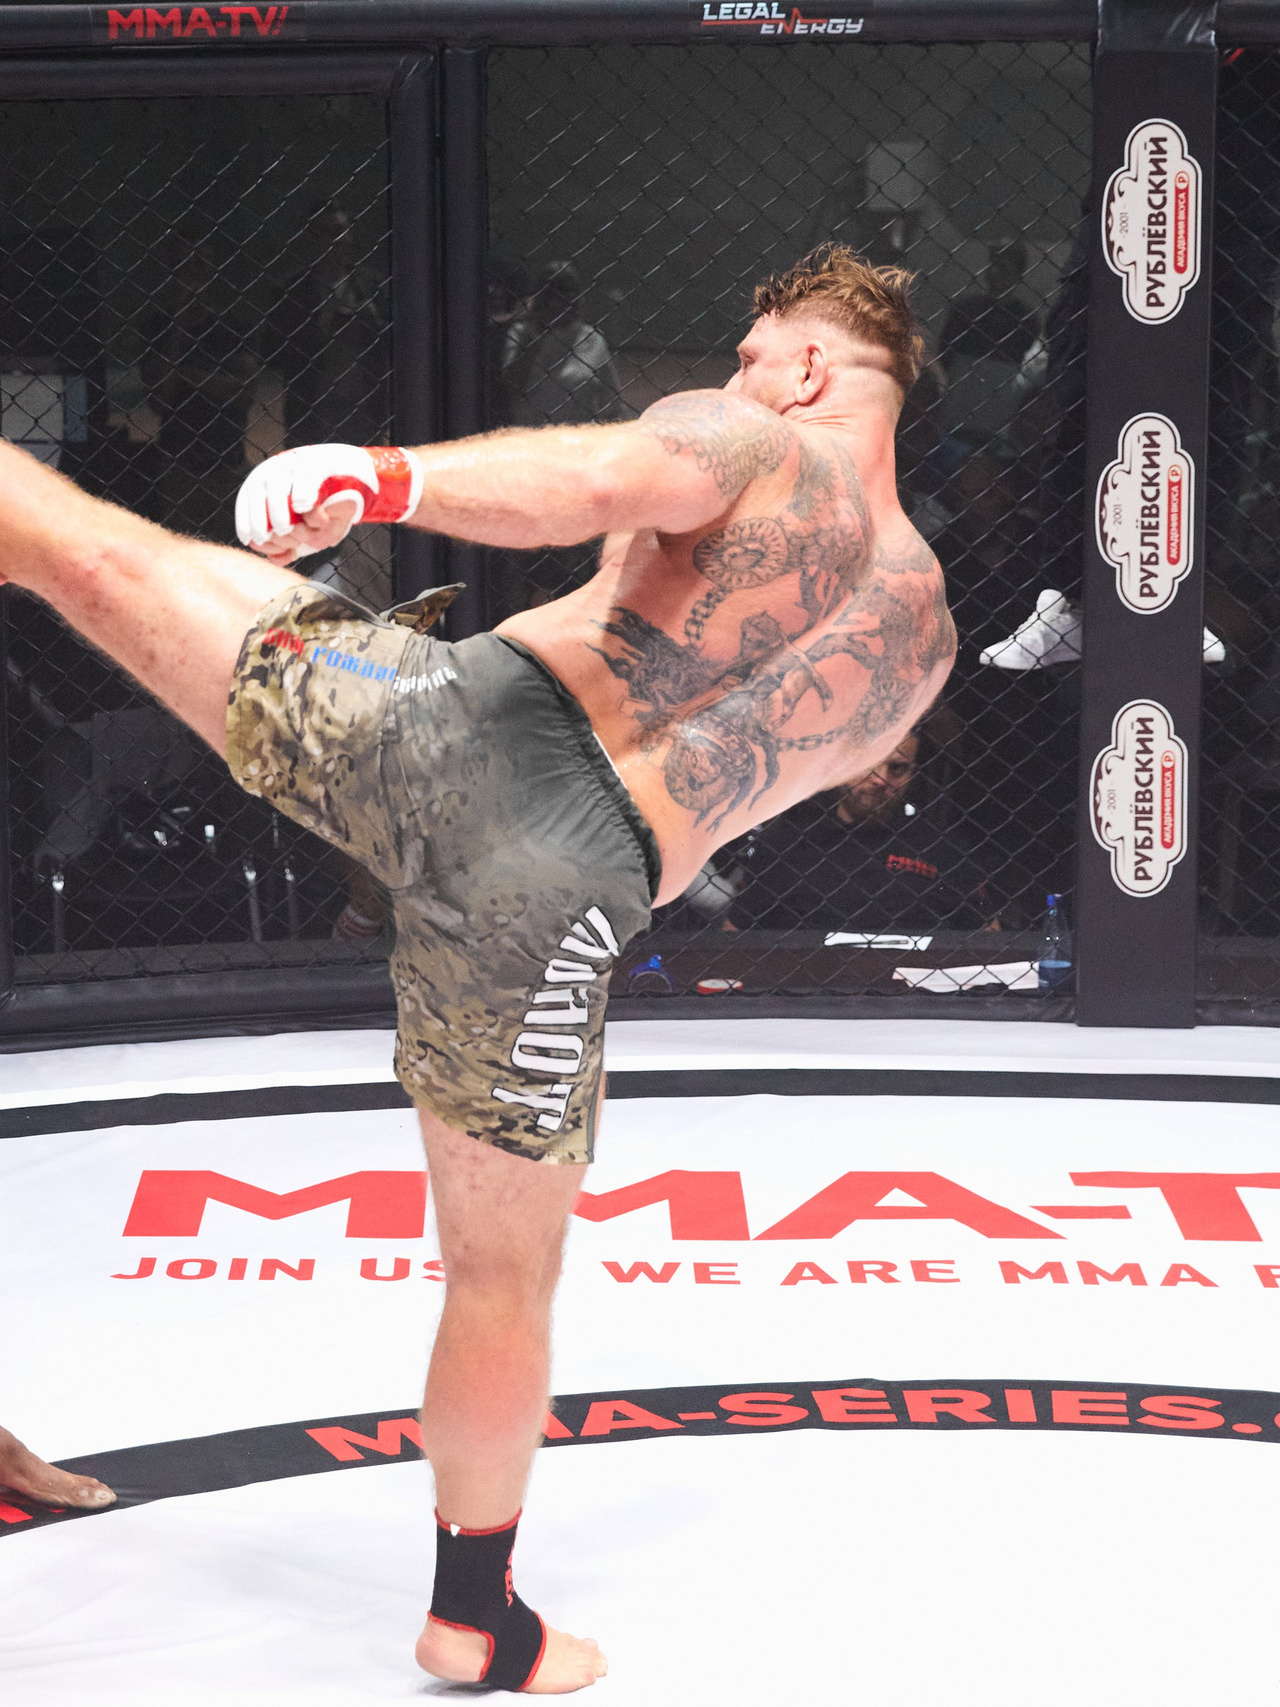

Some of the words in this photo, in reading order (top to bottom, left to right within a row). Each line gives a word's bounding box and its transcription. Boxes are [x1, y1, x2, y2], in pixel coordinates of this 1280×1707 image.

[703, 2, 786, 20] LEGAL
[760, 18, 864, 35] ENERGY
[1142, 136, 1168, 308] РУБЛЁВСКИЙ
[1136, 430, 1161, 598] РУБЛЁВСКИЙ
[1129, 717, 1154, 881] РУБЛЁВСКИЙ
[110, 1257, 316, 1281] JOIN
[601, 1260, 741, 1285] WE
[780, 1260, 961, 1286] ARE
[998, 1260, 1220, 1288] MMA
[305, 1388, 1280, 1462] MA-SERIES.
